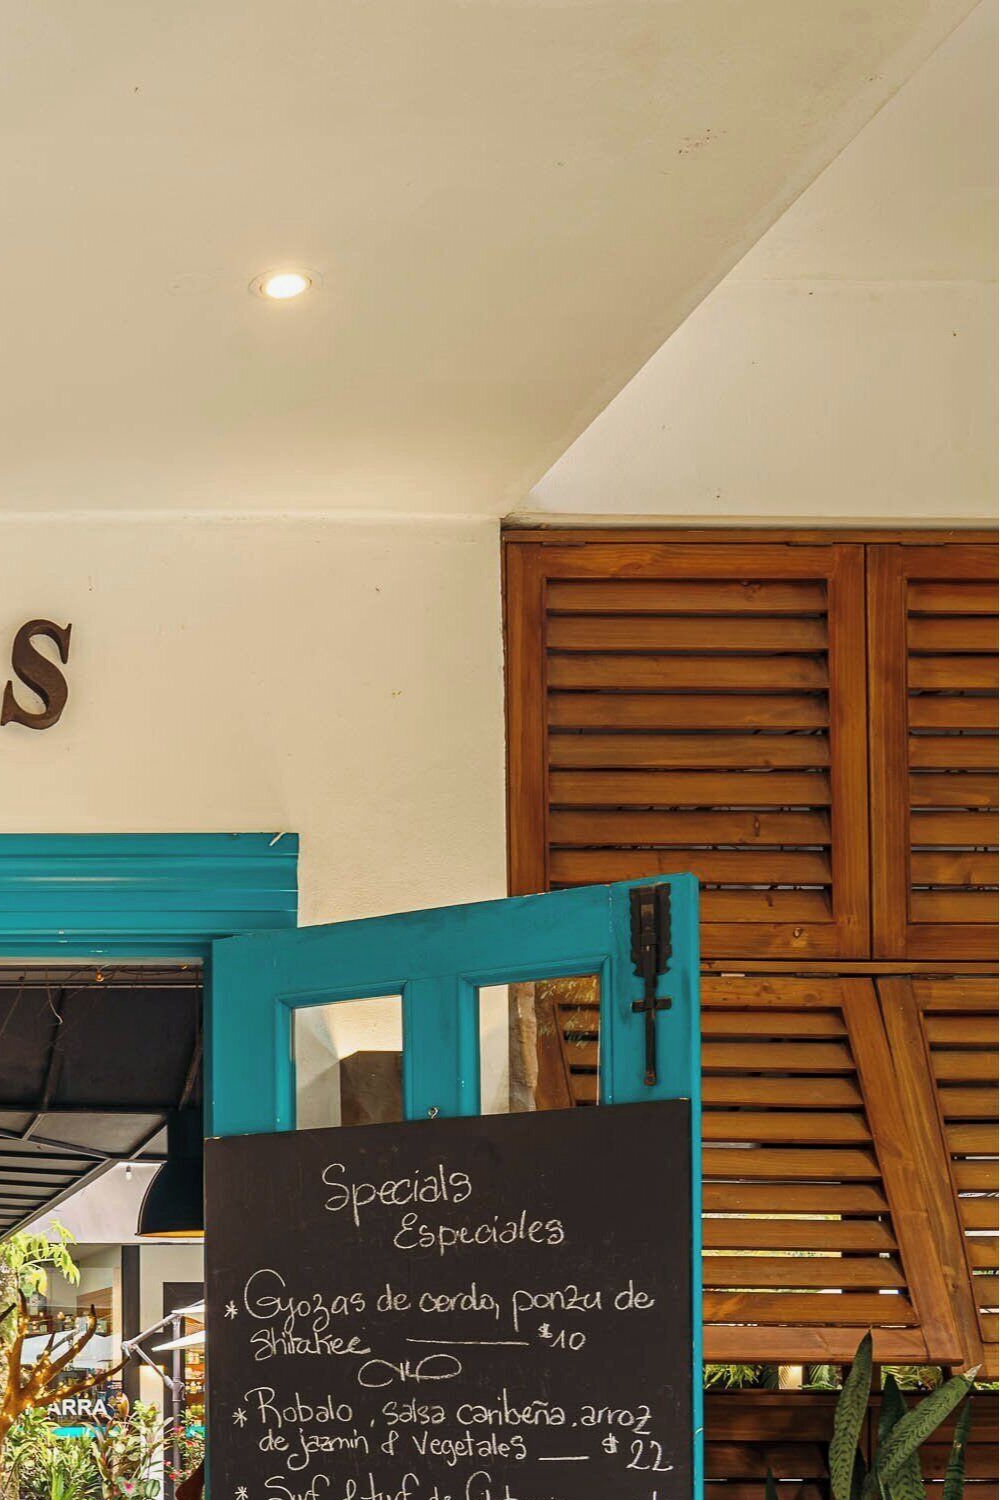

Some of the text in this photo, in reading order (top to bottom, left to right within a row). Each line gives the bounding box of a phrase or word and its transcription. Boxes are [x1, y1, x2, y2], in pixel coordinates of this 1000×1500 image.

[322, 1163, 473, 1227] Specials
[393, 1209, 565, 1257] Especiales
[244, 1268, 366, 1334] Gyozas
[377, 1283, 412, 1312] de
[511, 1284, 603, 1333] ponzu
[614, 1279, 656, 1310] de
[537, 1323, 586, 1350] $10
[581, 1405, 653, 1435] arroz
[259, 1429, 290, 1452] de
[381, 1430, 399, 1455] &
